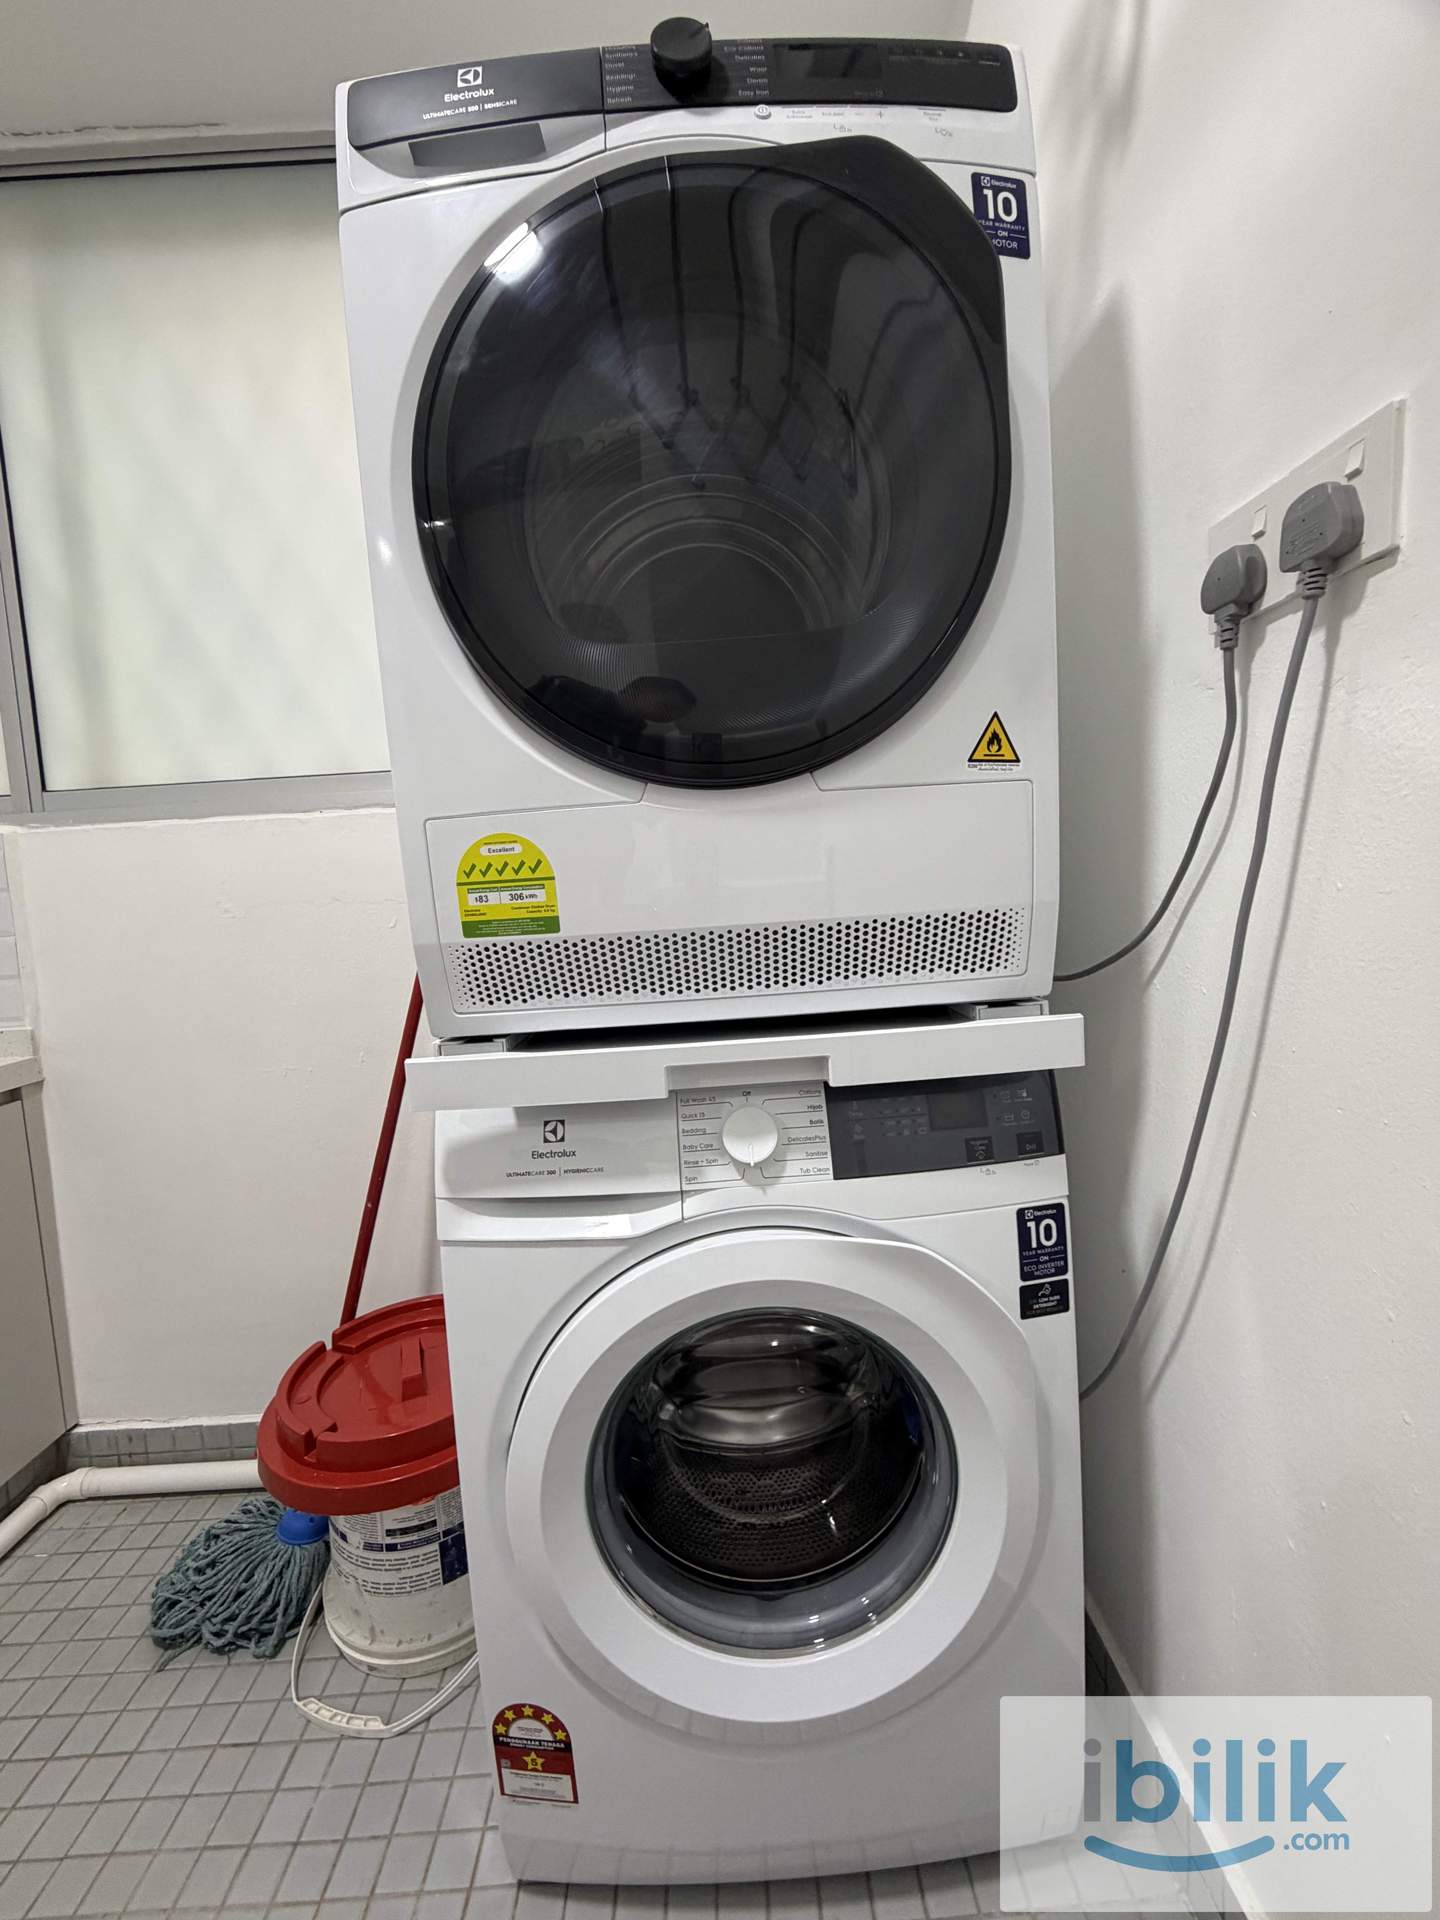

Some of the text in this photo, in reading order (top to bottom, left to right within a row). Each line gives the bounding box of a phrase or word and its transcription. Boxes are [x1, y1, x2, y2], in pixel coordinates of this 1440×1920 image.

[444, 88, 495, 102] Electrolux
[422, 107, 466, 120] ULTIMATECARE
[991, 180, 1017, 189] Electrolux
[983, 189, 1018, 222] 10
[995, 221, 1025, 231] WARRANTY
[487, 846, 515, 854] Excellent
[508, 892, 525, 902] 306
[531, 1149, 577, 1160] Electrolux
[705, 1158, 719, 1166] Spin
[1033, 1209, 1057, 1217] Electrolux
[1026, 1218, 1058, 1249] 10
[1037, 1246, 1065, 1254] WARRANTY
[1038, 1260, 1065, 1270] INVERTER
[1033, 1268, 1056, 1276] MOTOR
